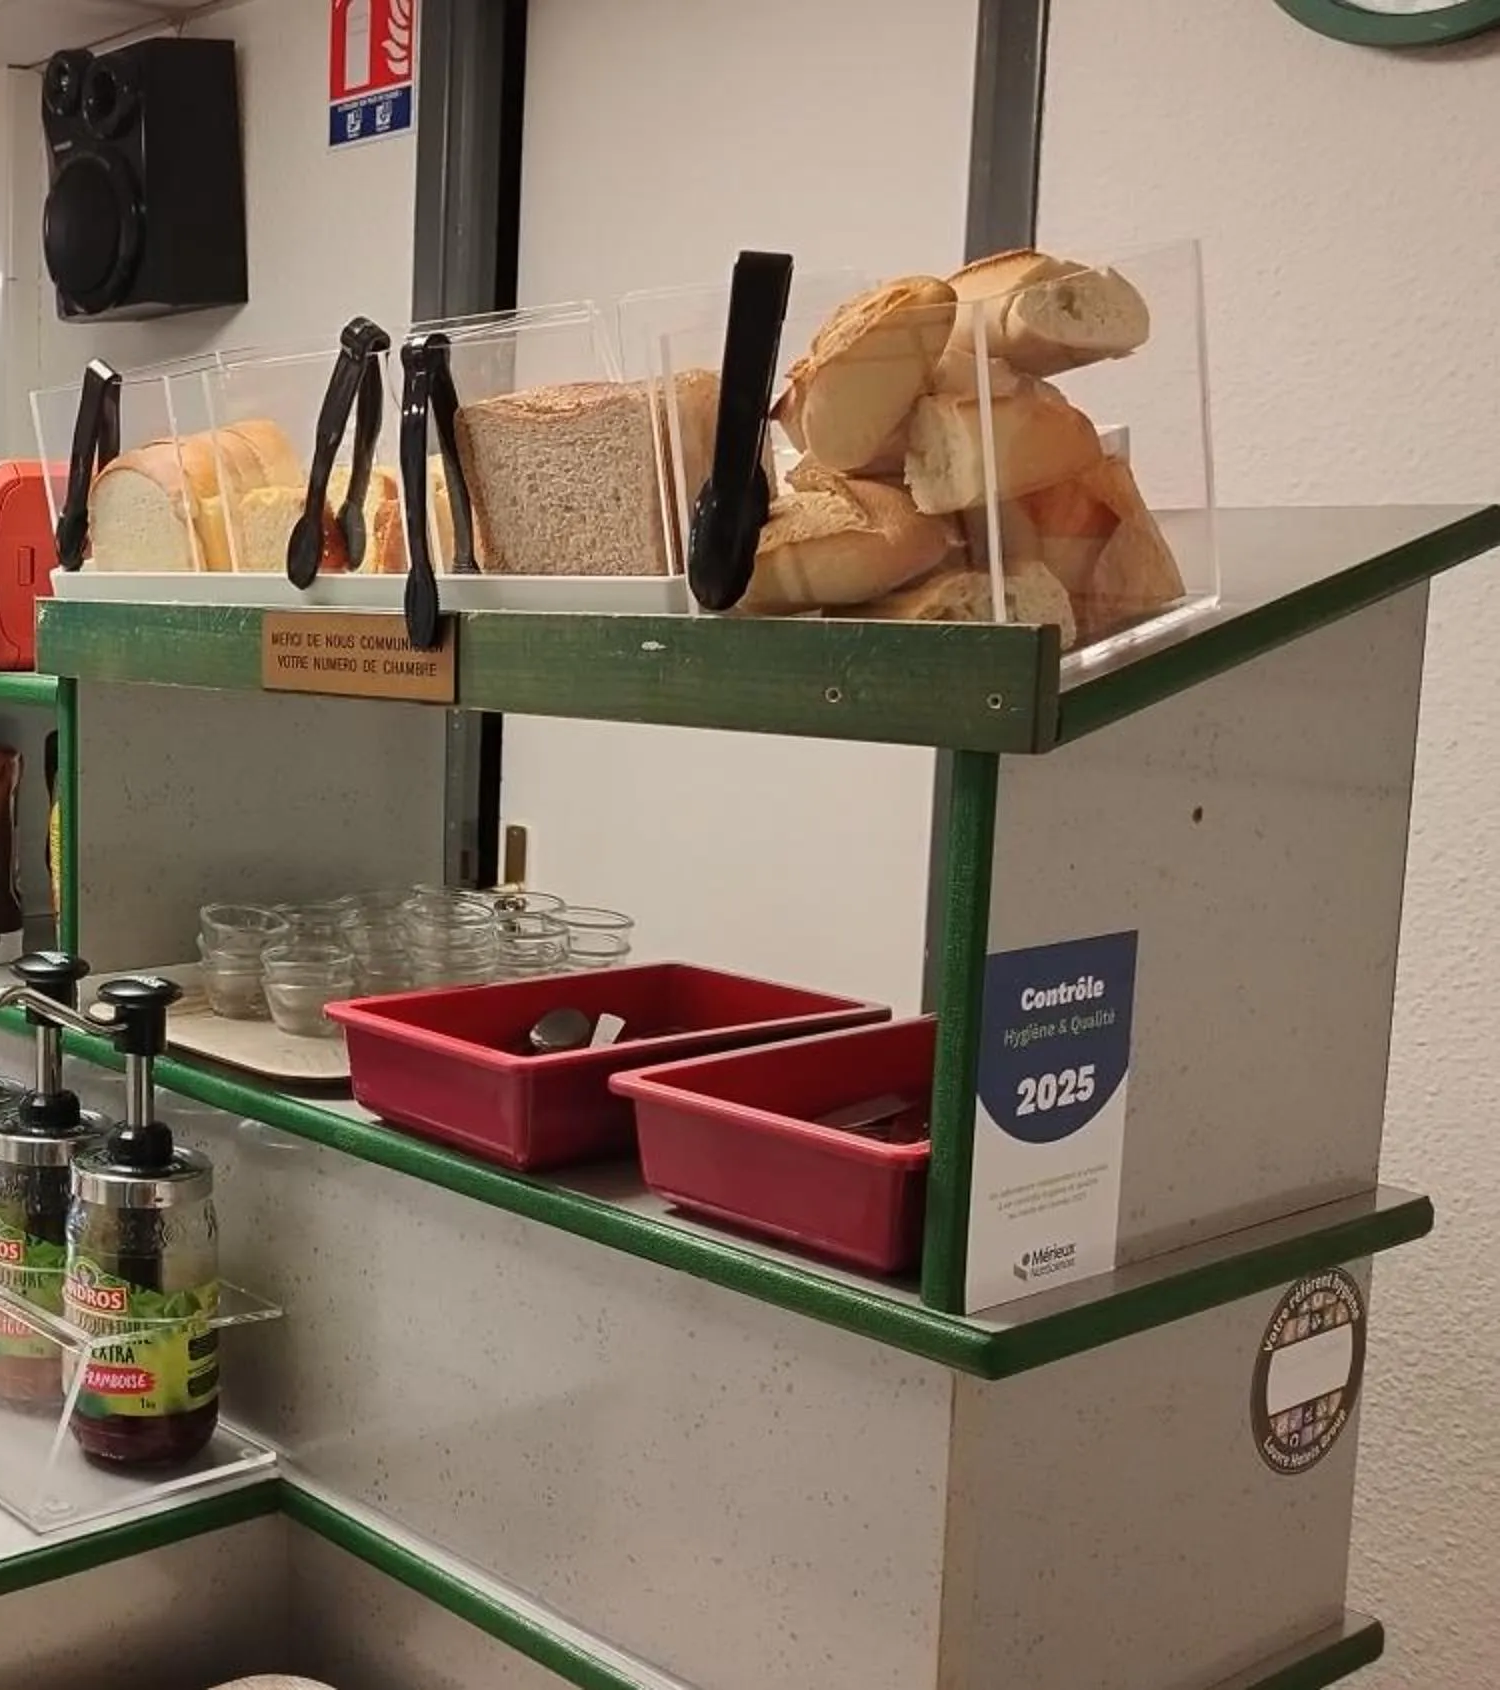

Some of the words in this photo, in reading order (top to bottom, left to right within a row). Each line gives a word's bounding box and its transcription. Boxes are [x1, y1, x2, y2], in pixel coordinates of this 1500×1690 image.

[271, 632, 302, 648] MERCI
[307, 633, 322, 648] DE
[325, 634, 356, 650] NOUS
[360, 635, 443, 653] COMMUNI
[277, 655, 309, 670] VOTRE
[363, 659, 378, 673] DE
[383, 660, 437, 677] CHAMBRE
[1020, 976, 1106, 1011] Contrôle
[1003, 1022, 1056, 1049] Hygiène
[1057, 1018, 1068, 1035] &
[1071, 1008, 1116, 1036] Qualité
[1016, 1064, 1096, 1116] 2025
[1031, 1243, 1077, 1266] Mérieux
[67, 1281, 123, 1310] NDROS
[92, 1345, 135, 1364] EXTRA
[84, 1369, 148, 1390] FRAMBOISE
